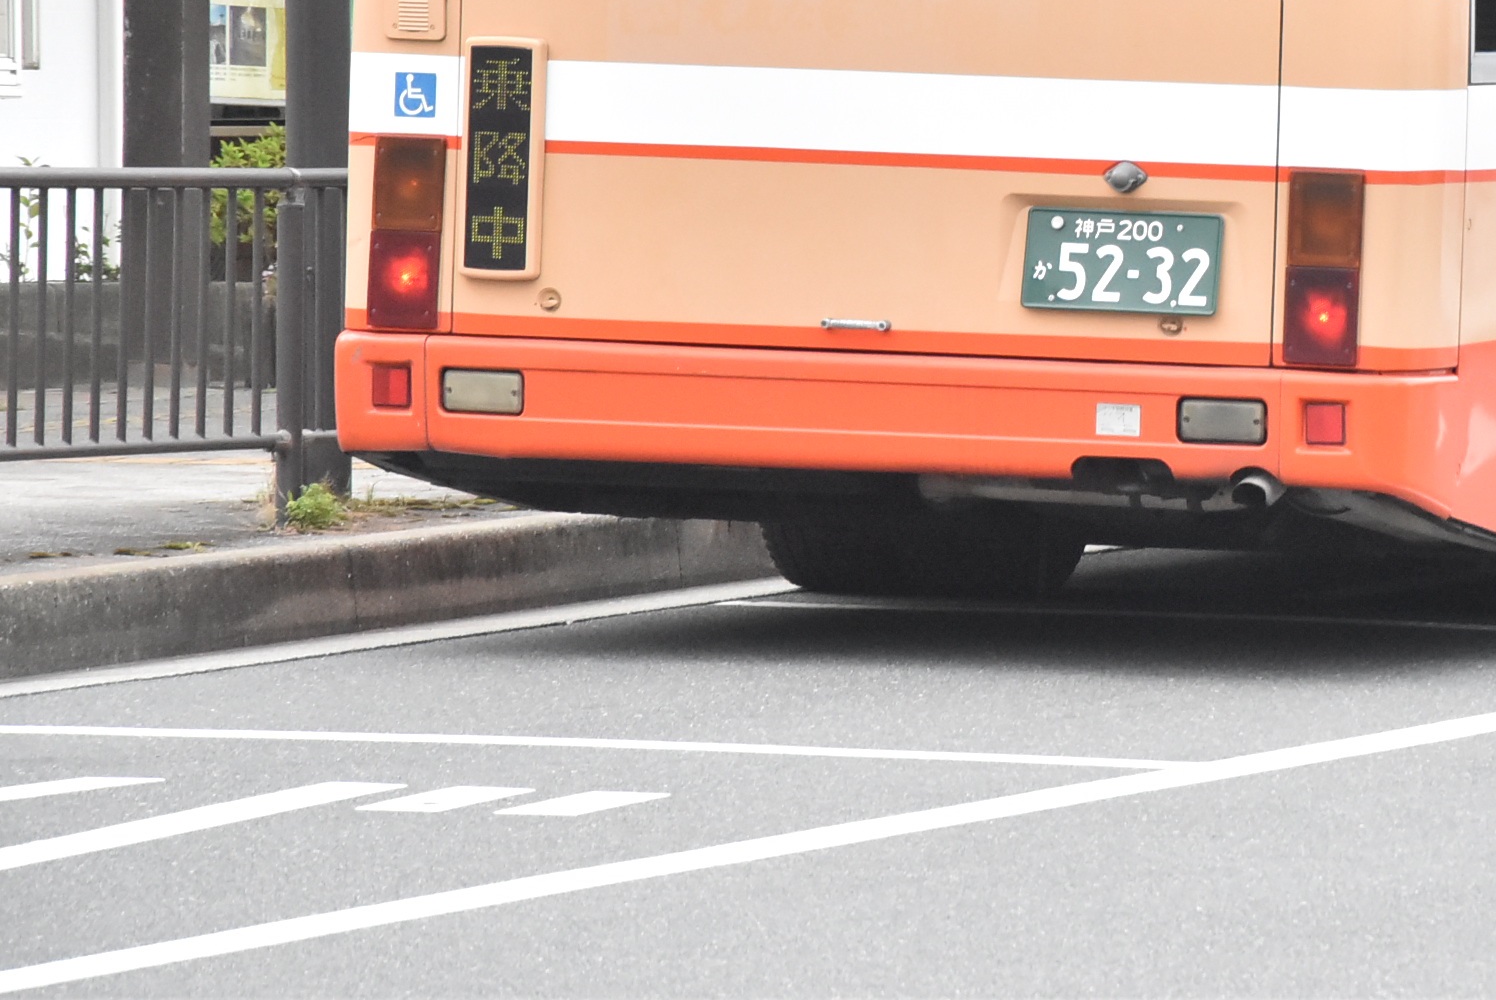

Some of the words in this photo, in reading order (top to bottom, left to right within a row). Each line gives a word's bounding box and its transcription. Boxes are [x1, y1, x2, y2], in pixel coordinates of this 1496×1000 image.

[472, 57, 532, 260] 乗降中
[1074, 217, 1164, 242] 神戸200
[1032, 260, 1053, 281] か
[1056, 241, 1211, 307] 52-32
